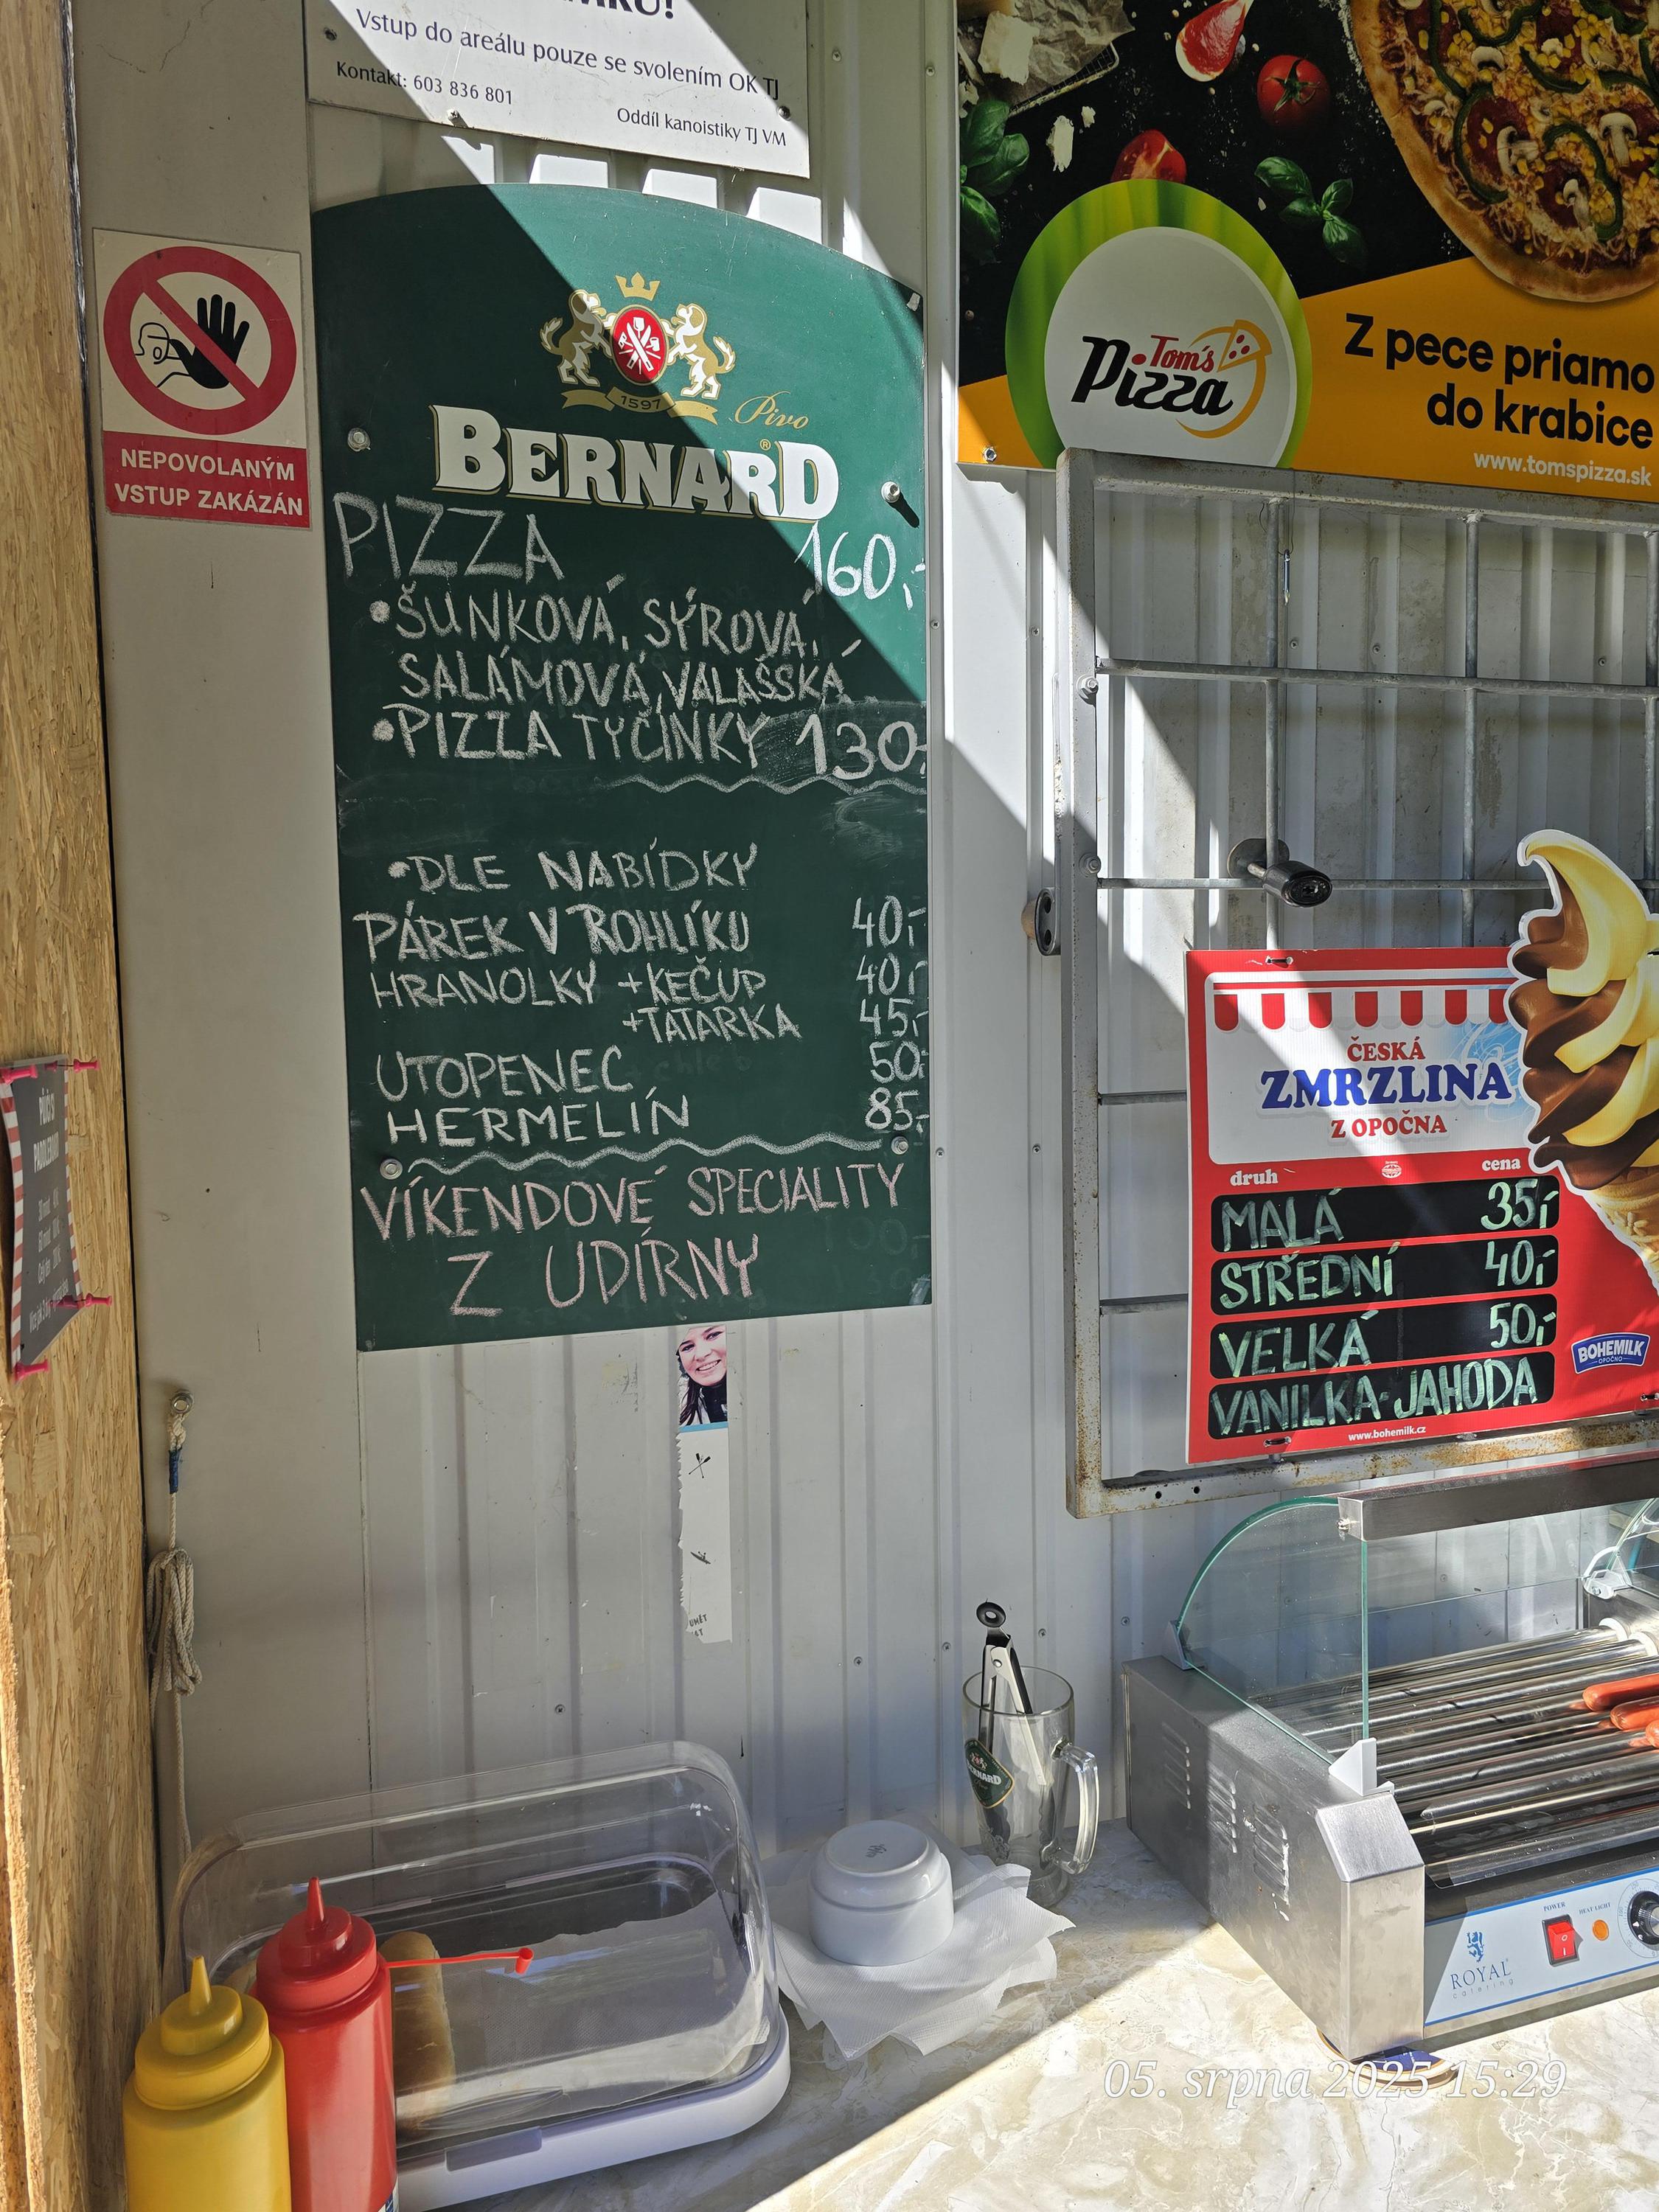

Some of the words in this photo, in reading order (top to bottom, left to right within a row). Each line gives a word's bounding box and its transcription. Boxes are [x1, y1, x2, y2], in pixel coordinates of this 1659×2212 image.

[357, 10, 417, 40] Vstup
[425, 21, 452, 44] do
[461, 27, 525, 57] areálu
[533, 43, 597, 69] pouze
[605, 55, 626, 72] se
[633, 57, 721, 88] svolením
[729, 73, 757, 94] OK
[762, 77, 779, 100] TJ
[337, 61, 407, 89] Kontakt:
[414, 74, 442, 94] 603
[449, 80, 479, 100] 836
[485, 88, 513, 105] 801
[616, 107, 660, 128] Oddíl
[664, 114, 741, 142] kanoistiky
[745, 126, 757, 145] TJ
[764, 130, 787, 146] VM
[1071, 336, 1233, 415] Pizza
[1344, 313, 1375, 358] Z
[1386, 328, 1494, 373] pece
[1505, 338, 1655, 395] priamo
[621, 395, 661, 410] 1597
[734, 391, 809, 429] Pivo
[1427, 383, 1483, 429] do
[1494, 389, 1654, 450] krabice
[121, 448, 294, 481] NEPOVOLANÝM
[428, 404, 840, 524] BERNARD
[1474, 453, 1652, 486] www.tomspizza.sk
[115, 483, 190, 506] VSTUP
[198, 489, 302, 516] ZAKÁZÁN
[333, 491, 566, 584] PIZZA
[383, 704, 561, 761] PIZZA
[572, 704, 772, 768] TYČINKY
[406, 855, 510, 893] DLE
[538, 838, 758, 893] NABÍDKY
[352, 899, 524, 963] PÁREK
[528, 906, 559, 956] V
[566, 900, 749, 954] ROHLÍKU
[370, 958, 597, 1009] HRANOLKY
[376, 1043, 633, 1102] UTOPENEC
[1347, 1035, 1426, 1063] ČESKÁ
[1260, 1062, 1512, 1110] ZMRZLINA
[388, 1088, 689, 1147] HERMELÍN
[1331, 1119, 1346, 1138] Z
[1352, 1110, 1447, 1137] OPOČNA
[1230, 1169, 1278, 1186] druh
[1481, 1158, 1520, 1172] cena
[361, 1165, 667, 1240] VÍKENDOVÉ
[688, 1161, 905, 1216] SPECIALITY
[1221, 1186, 1345, 1252] MALÁ
[448, 1250, 504, 1318] Z
[546, 1228, 759, 1309] UDÍRNY
[1219, 1241, 1401, 1308] STŘEDNÍ
[1218, 1309, 1379, 1377] VELKÁ
[1578, 1339, 1645, 1363] BOHEMILK
[1599, 1356, 1623, 1364] OPOČNO
[1349, 1426, 1426, 1441] www.bohemilk.cz
[1543, 1902, 1566, 1912] POWER
[1579, 1907, 1593, 1915] HEAT
[1595, 1902, 1611, 1910] LIGHT
[1450, 1961, 1512, 1989] ROYAL
[1453, 1978, 1514, 1999] catering
